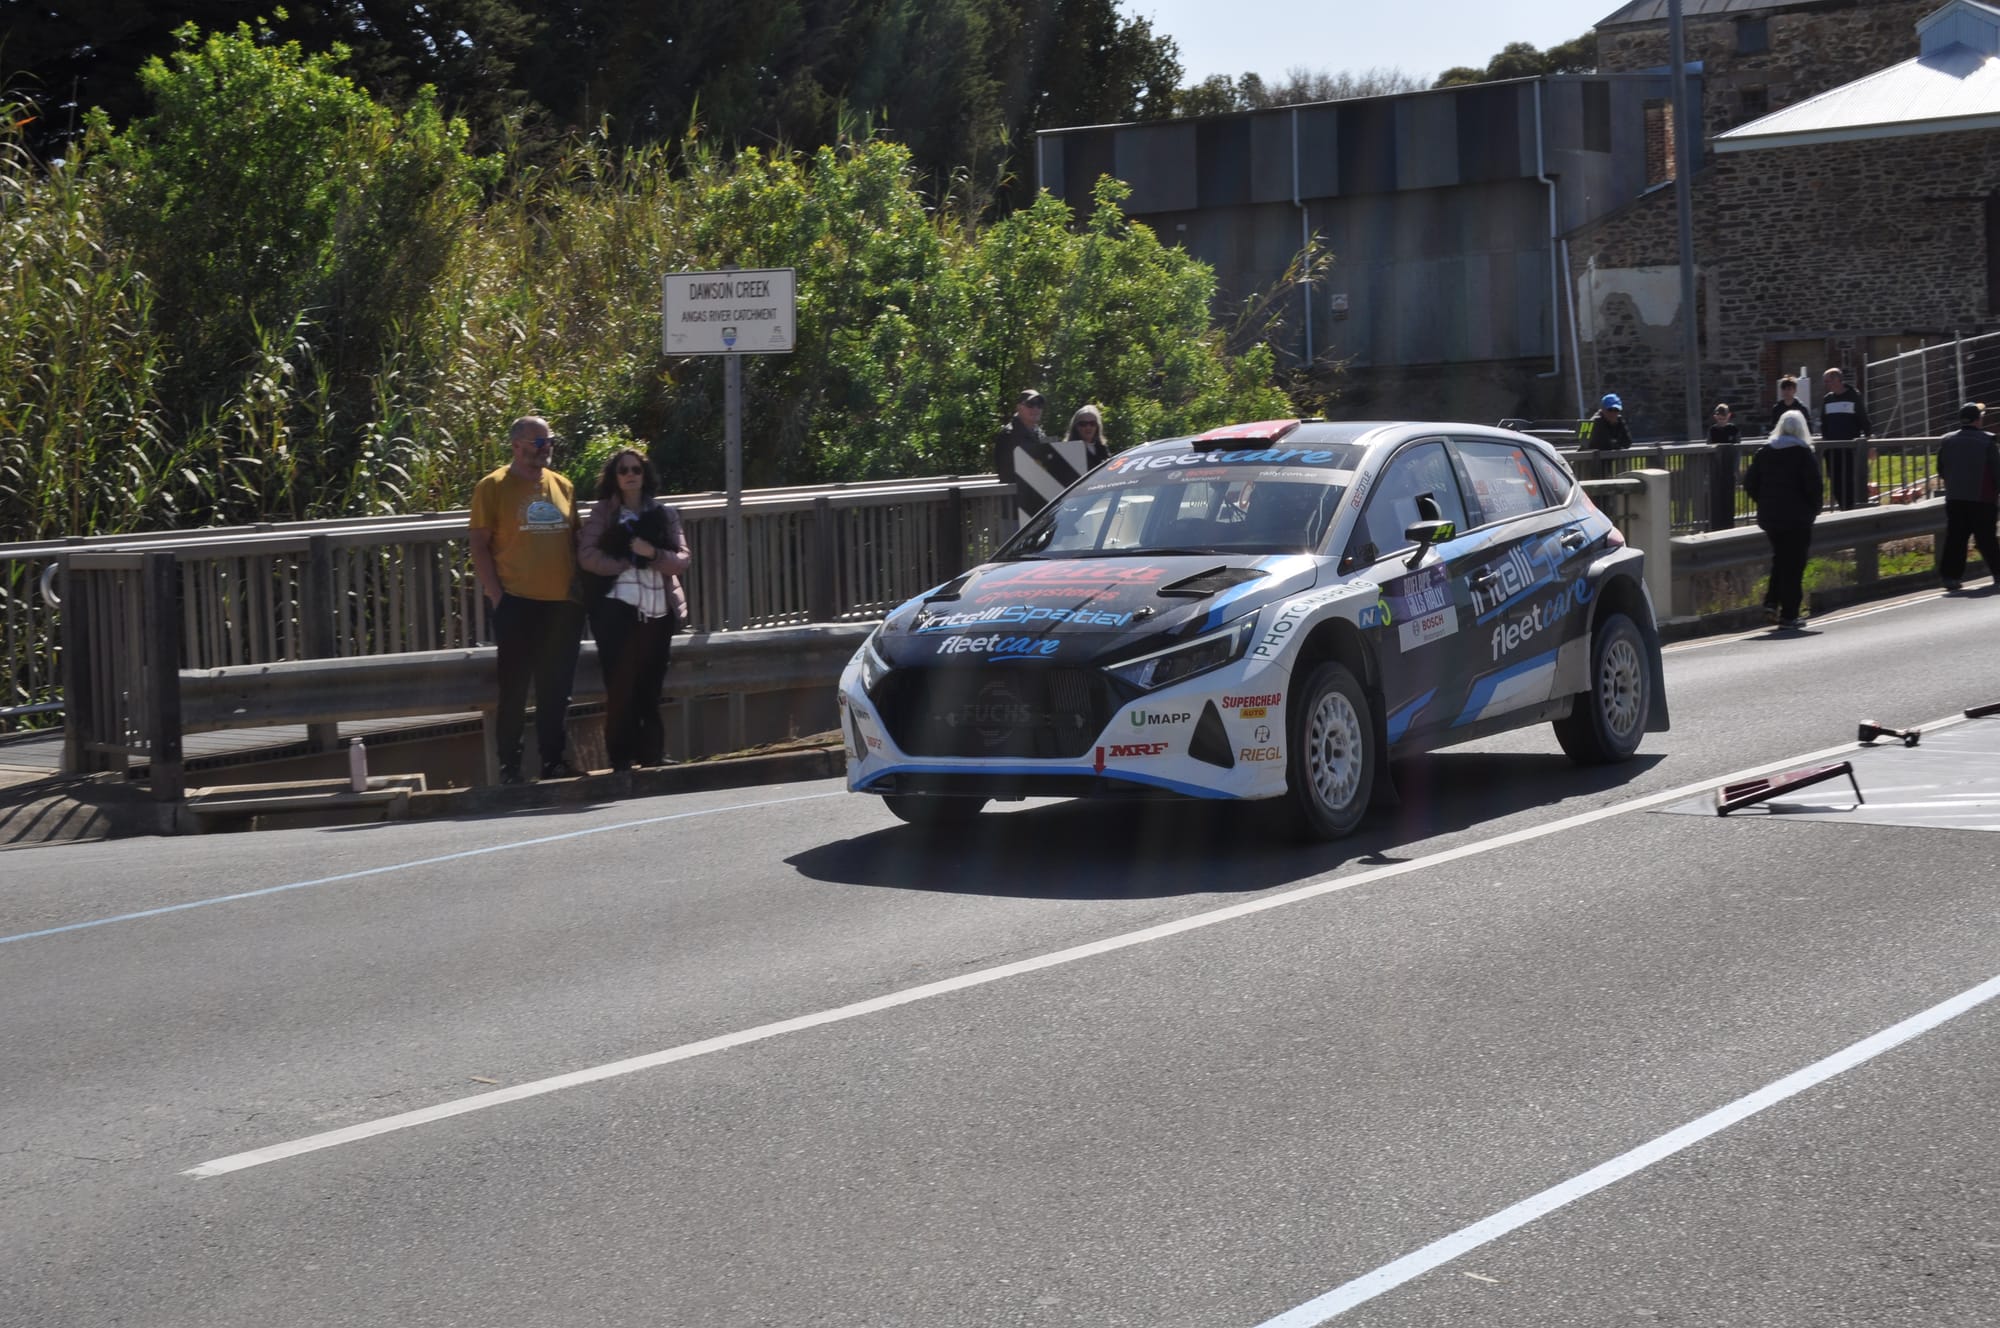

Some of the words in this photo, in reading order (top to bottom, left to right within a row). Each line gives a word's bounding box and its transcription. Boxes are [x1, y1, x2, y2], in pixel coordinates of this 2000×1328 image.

[689, 282, 733, 300] DAWSON
[735, 280, 770, 298] CREEK
[681, 311, 706, 322] ANGAS
[709, 309, 732, 321] RIVER
[733, 308, 777, 321] CATCHMENT
[1117, 448, 1334, 475] fleetcare
[1511, 450, 1538, 496] 5
[1421, 613, 1445, 631] BOSCH
[1490, 577, 1595, 661] fleetcare
[935, 634, 1061, 655] fleetcare
[1222, 692, 1282, 708] SUPERCHEAP
[1243, 709, 1266, 717] AUTO
[1109, 742, 1169, 757] MRF
[1240, 747, 1283, 761] RIEGL
